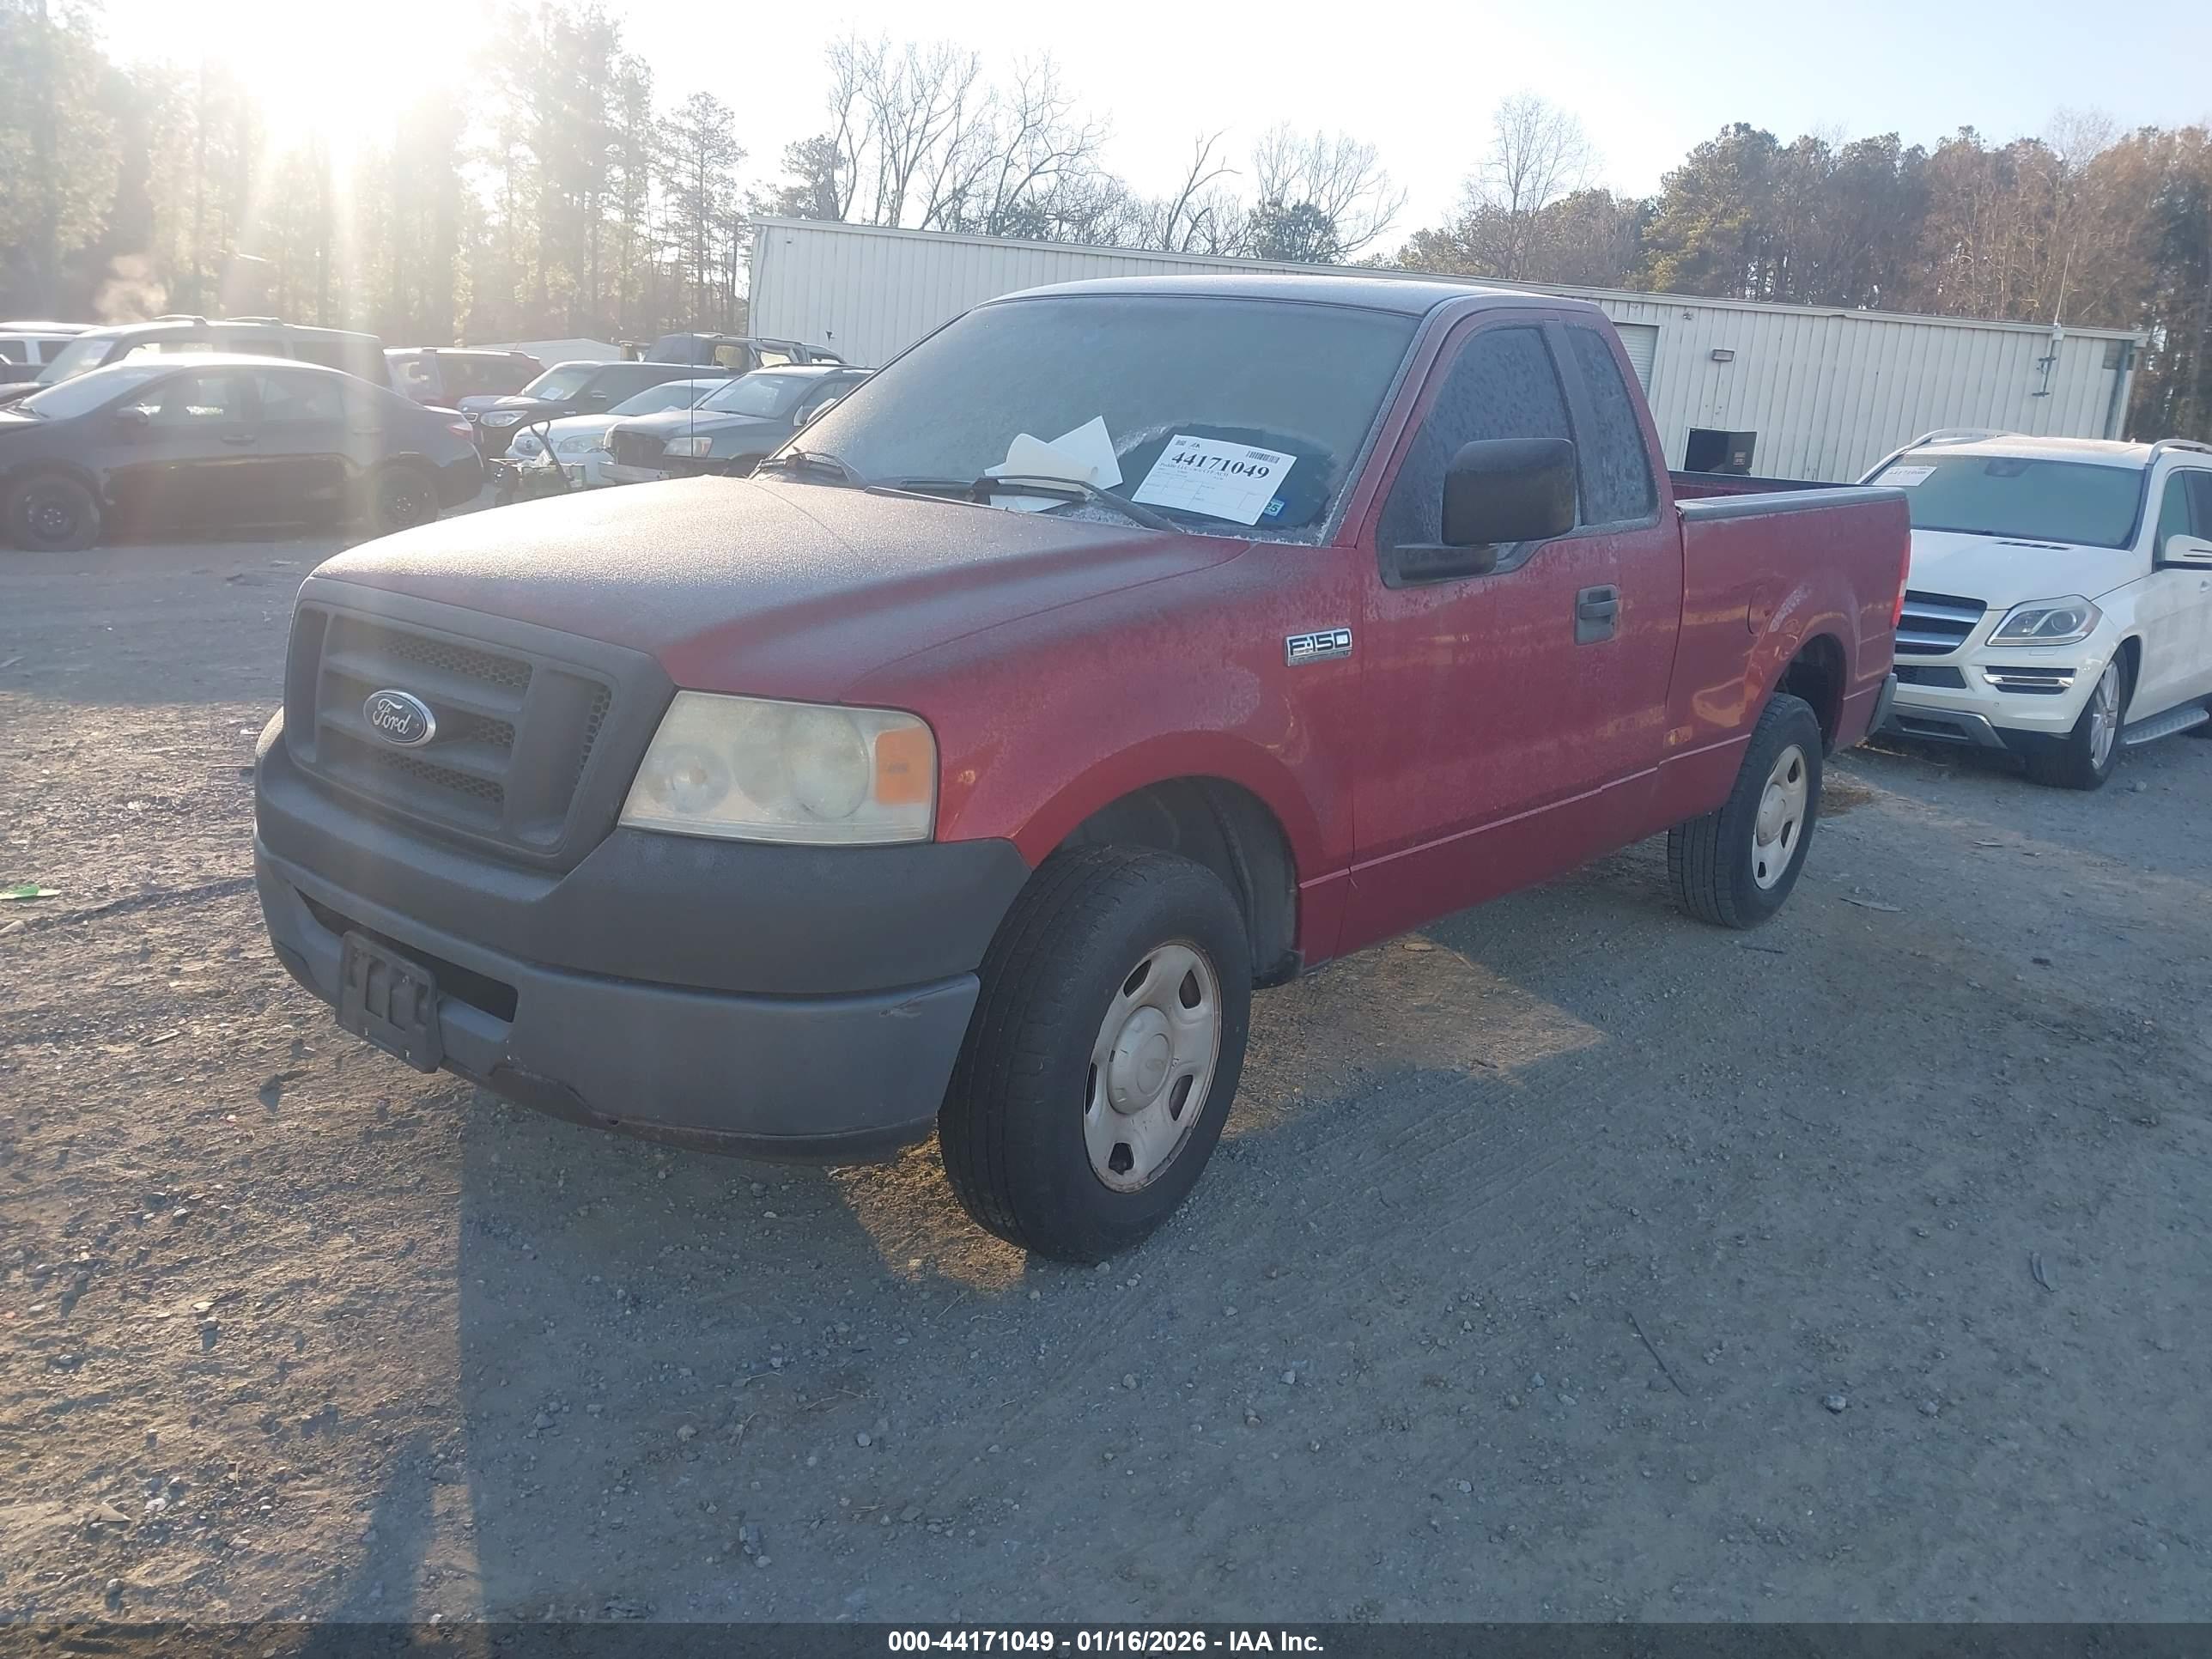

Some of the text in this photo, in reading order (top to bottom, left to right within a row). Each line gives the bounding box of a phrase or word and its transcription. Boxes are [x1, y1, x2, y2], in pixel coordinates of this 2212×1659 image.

[1171, 452, 1270, 478] 44171049
[1288, 630, 1351, 656] F-150
[372, 698, 411, 735] Ford
